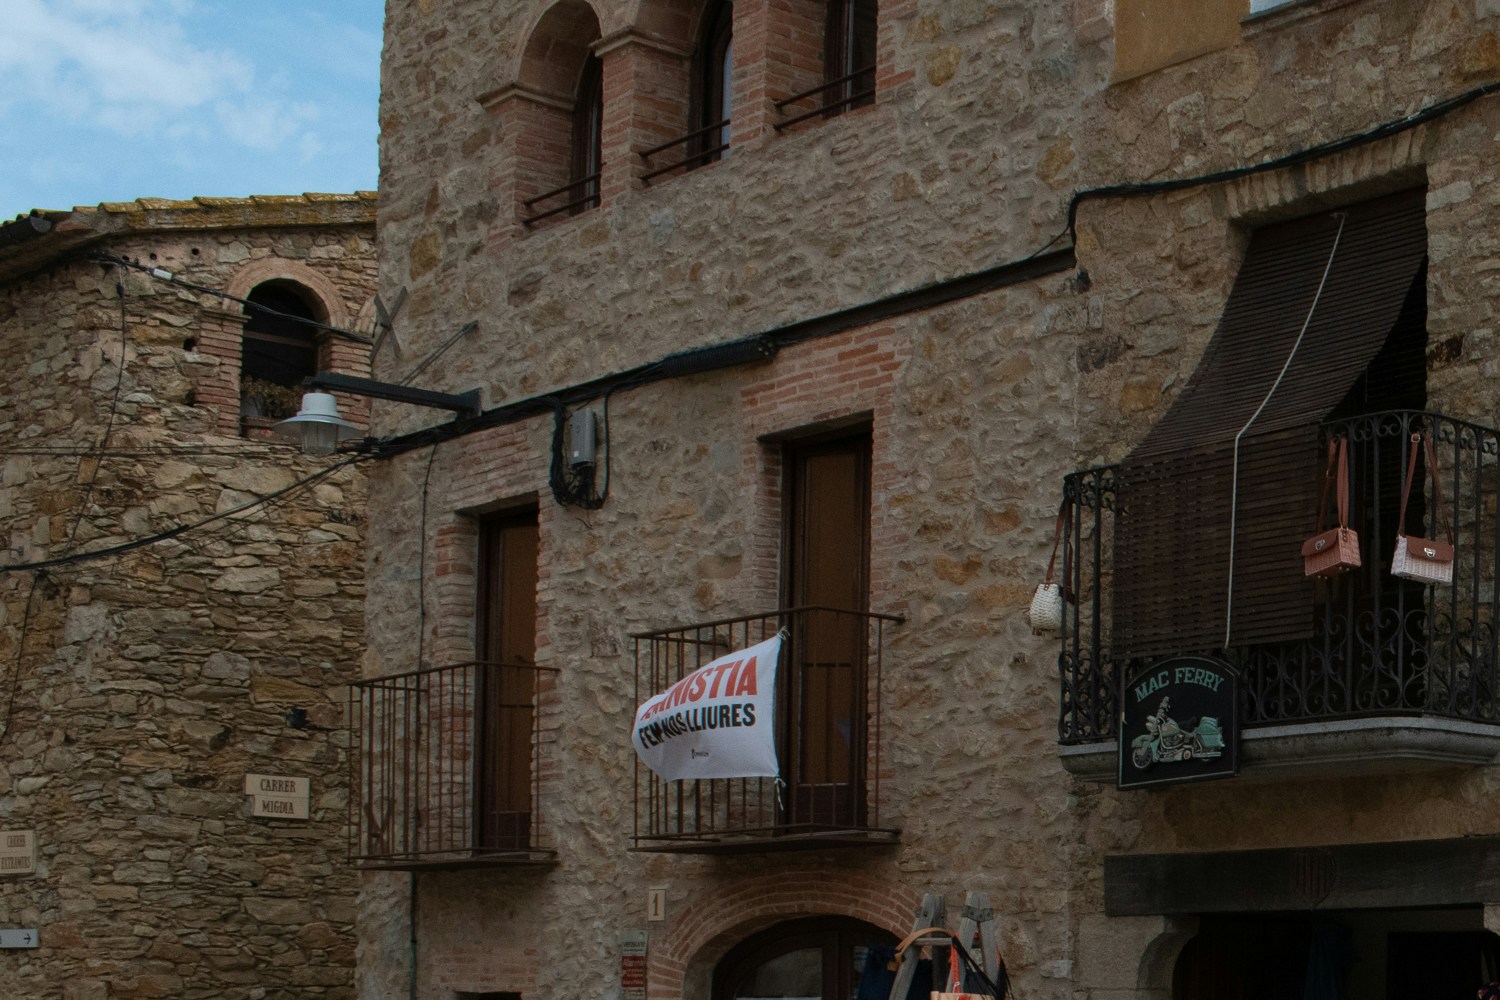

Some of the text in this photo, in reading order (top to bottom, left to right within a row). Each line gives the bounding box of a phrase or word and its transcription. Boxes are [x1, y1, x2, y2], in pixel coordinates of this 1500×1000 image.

[1135, 667, 1224, 702] MAC FERRY
[685, 703, 756, 732] LLIURES
[260, 778, 296, 792] CARRER
[652, 893, 660, 916] 1
